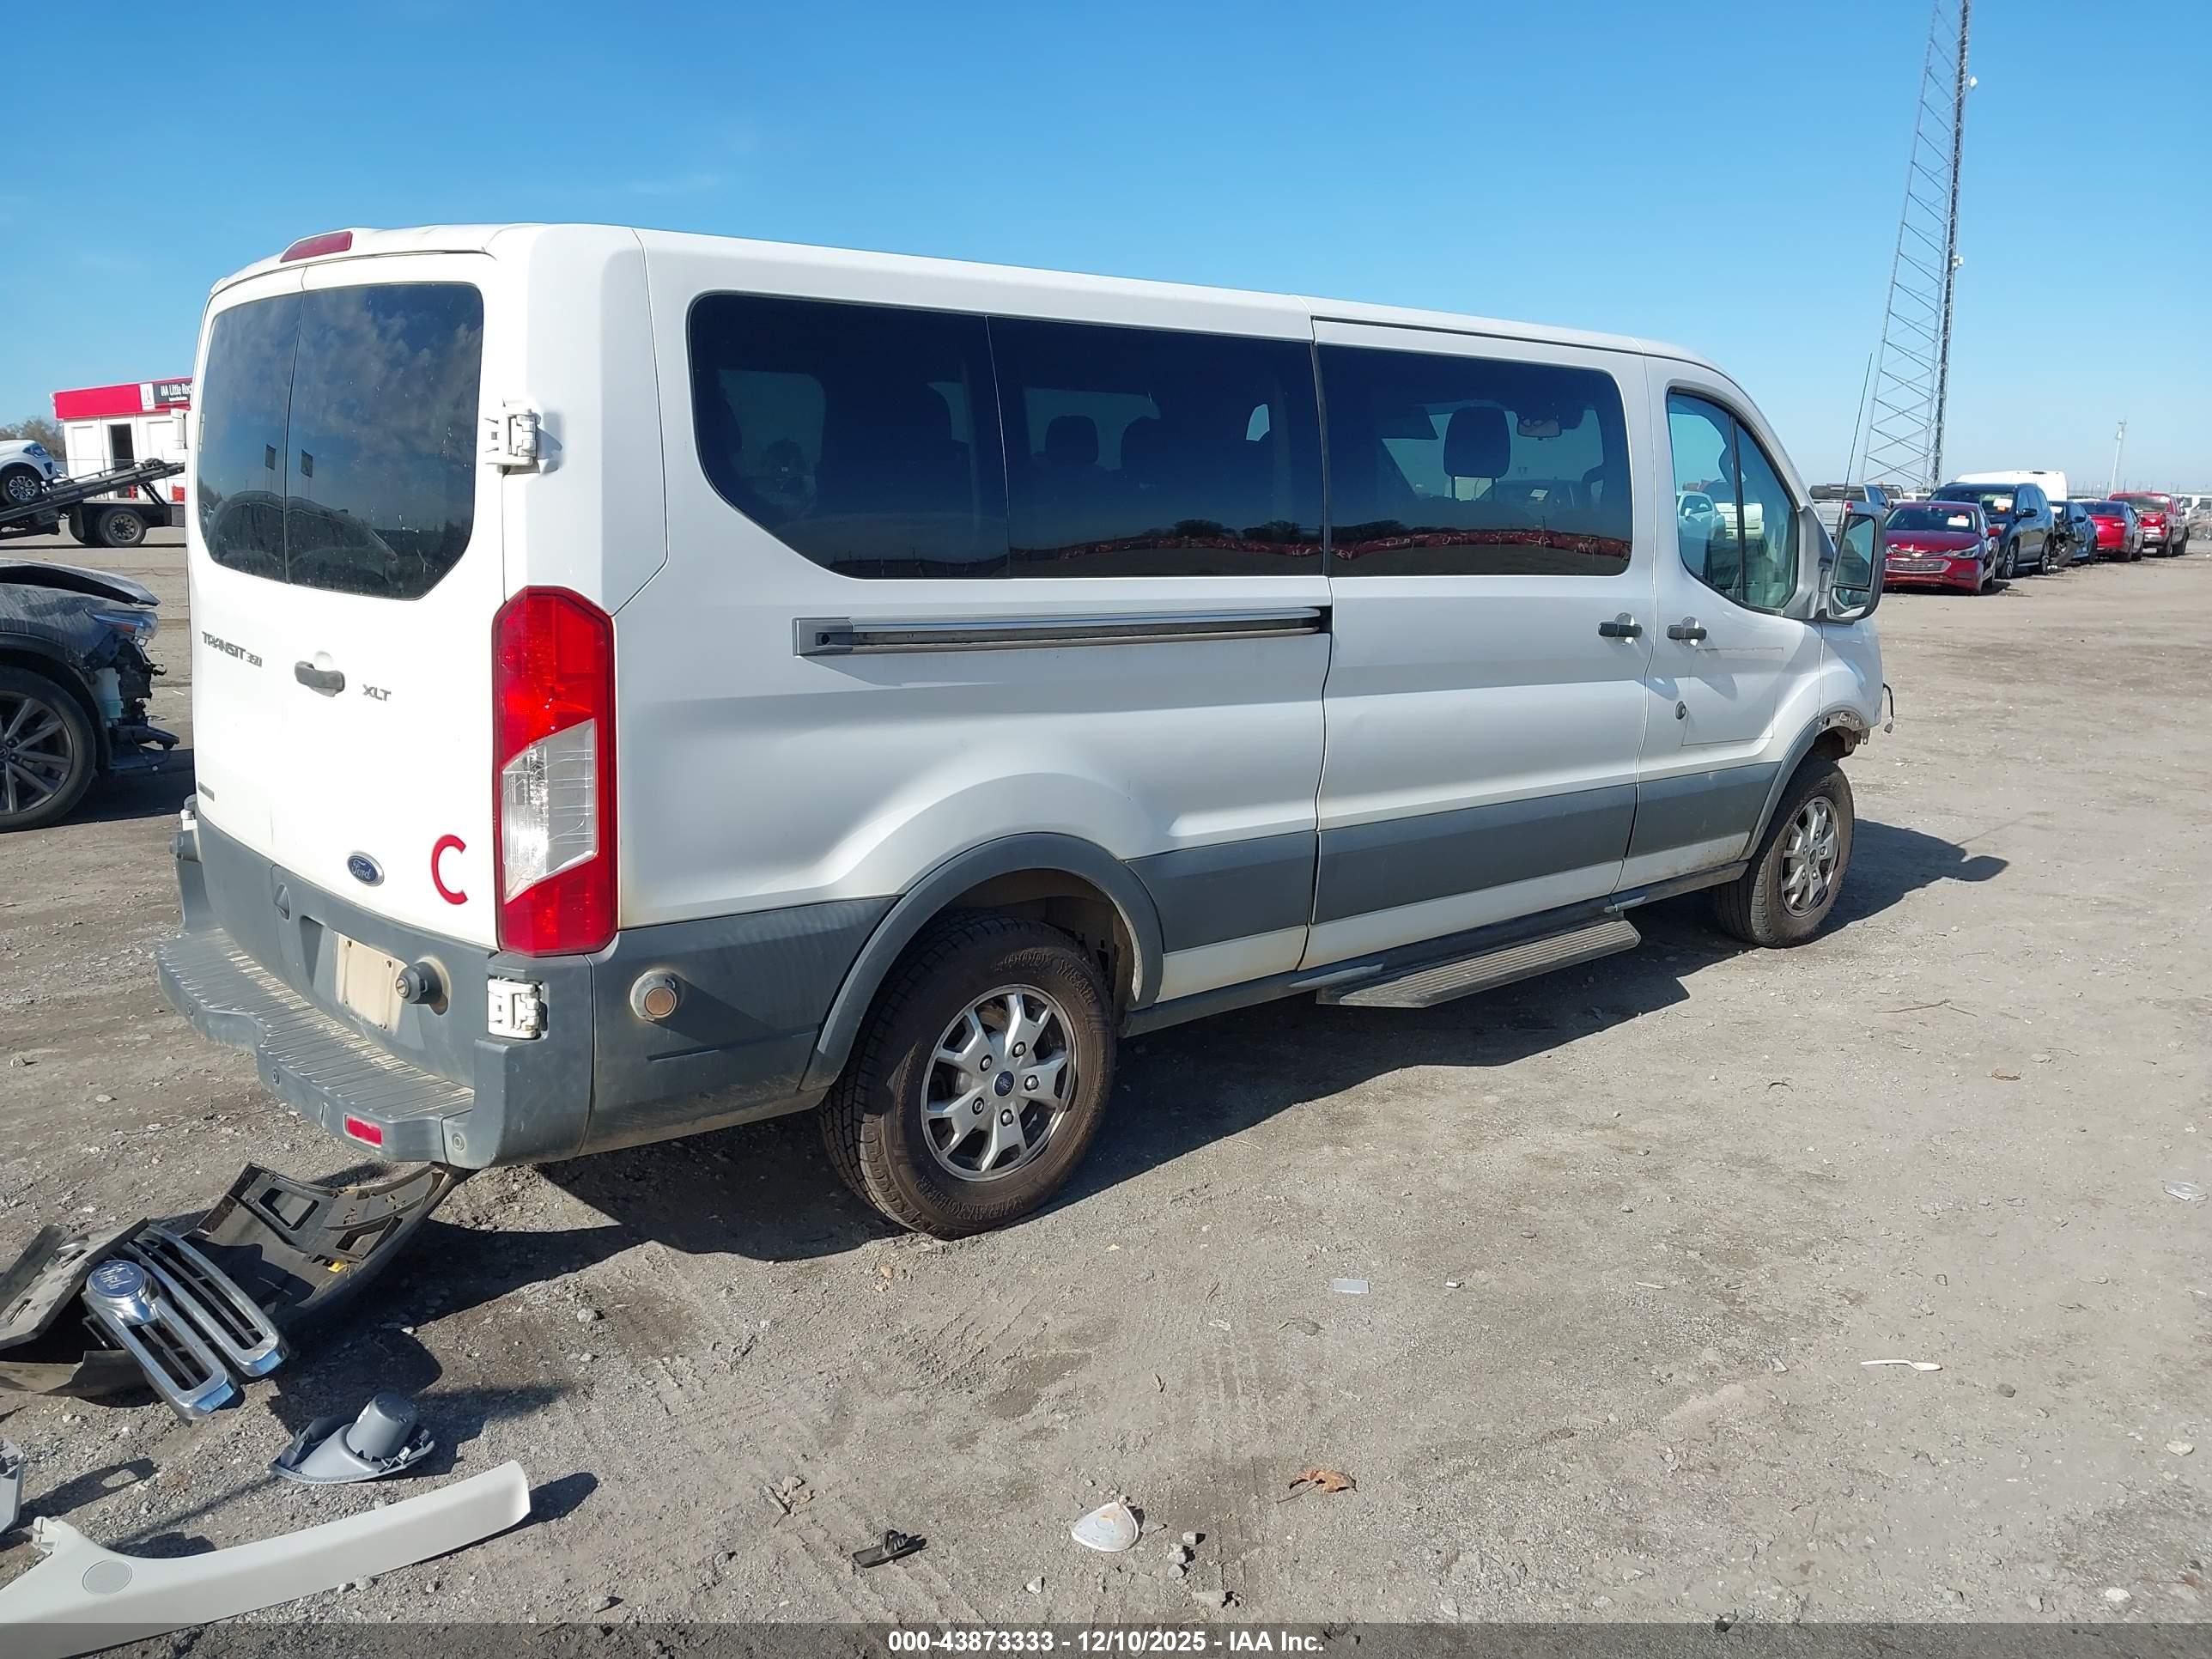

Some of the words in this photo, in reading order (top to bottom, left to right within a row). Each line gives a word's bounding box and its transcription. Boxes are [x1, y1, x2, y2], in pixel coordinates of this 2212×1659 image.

[169, 384, 181, 396] Little
[202, 631, 246, 660] TRANSIT
[362, 684, 392, 702] XLT
[351, 859, 372, 880] Ford
[431, 834, 468, 905] C
